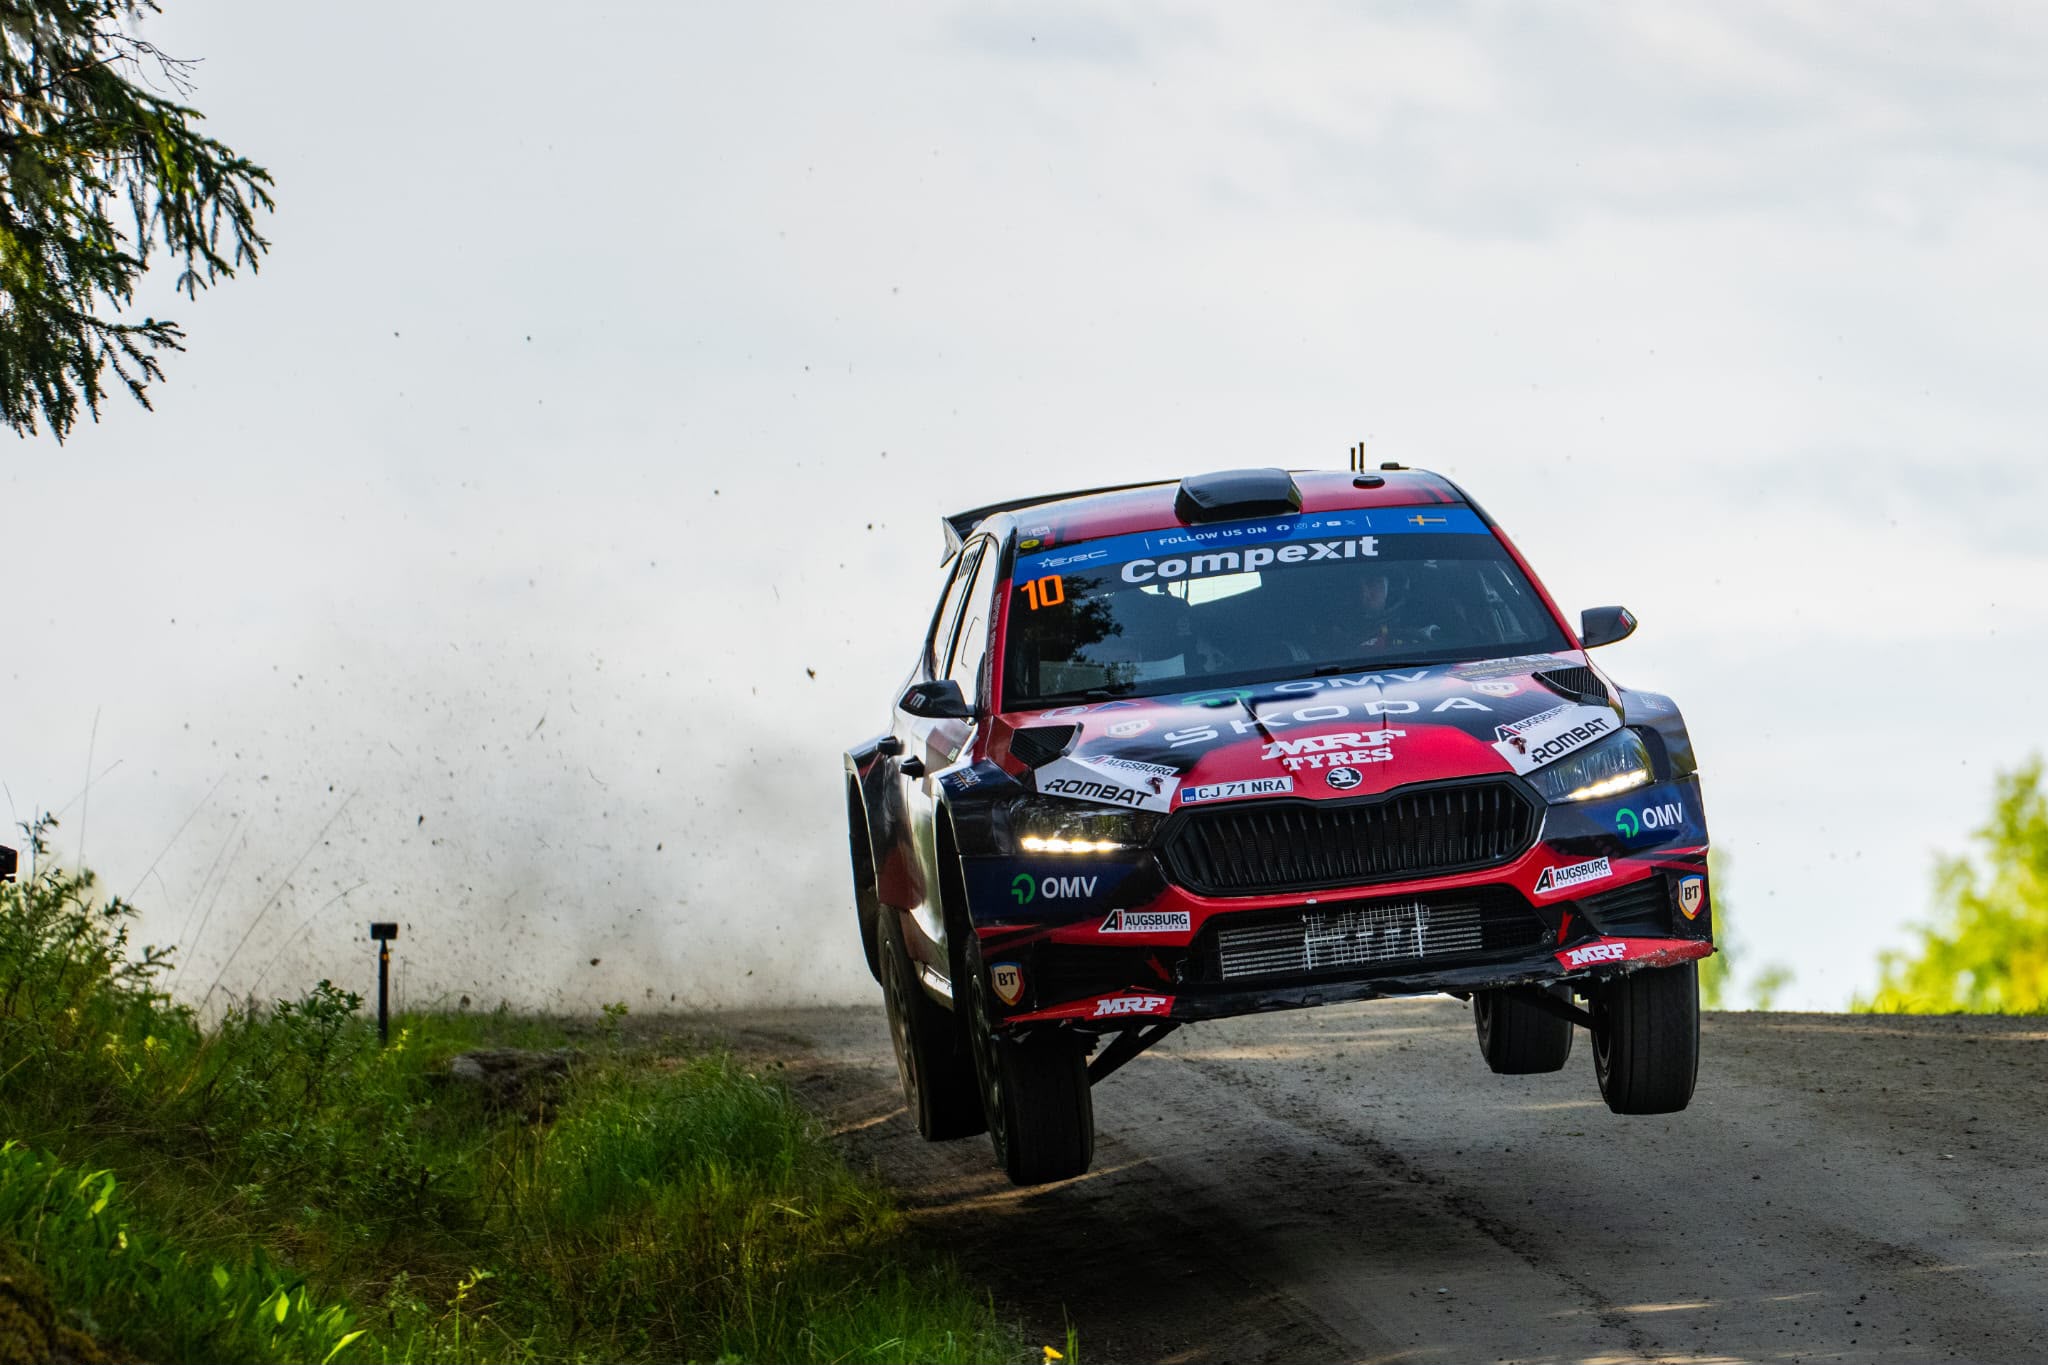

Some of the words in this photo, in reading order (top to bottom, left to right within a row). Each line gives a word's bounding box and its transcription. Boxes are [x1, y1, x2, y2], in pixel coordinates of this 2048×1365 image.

[1159, 531, 1219, 546] FOLLOW
[1222, 528, 1243, 538] US
[1246, 526, 1268, 536] ON
[1120, 536, 1379, 584] Compexit
[1020, 574, 1065, 611] 10
[1274, 670, 1430, 693] OMV
[1261, 729, 1406, 761] MRF
[1532, 718, 1610, 765] ROMBAT
[1104, 759, 1174, 776] AUGSBURG
[1283, 747, 1394, 771] TYRES
[1044, 778, 1152, 807] ROMBAT
[1198, 786, 1220, 799] CJ
[1226, 783, 1246, 795] 71
[1251, 780, 1286, 792] NRA
[1642, 803, 1683, 829] OMV
[1556, 860, 1608, 882] AUGSBURG
[1041, 876, 1098, 899] OMV
[1684, 885, 1700, 901] BT
[1124, 913, 1188, 926] AUGSBURG
[1566, 943, 1627, 965] MRF
[996, 971, 1016, 986] BT
[1094, 997, 1166, 1017] MRF
